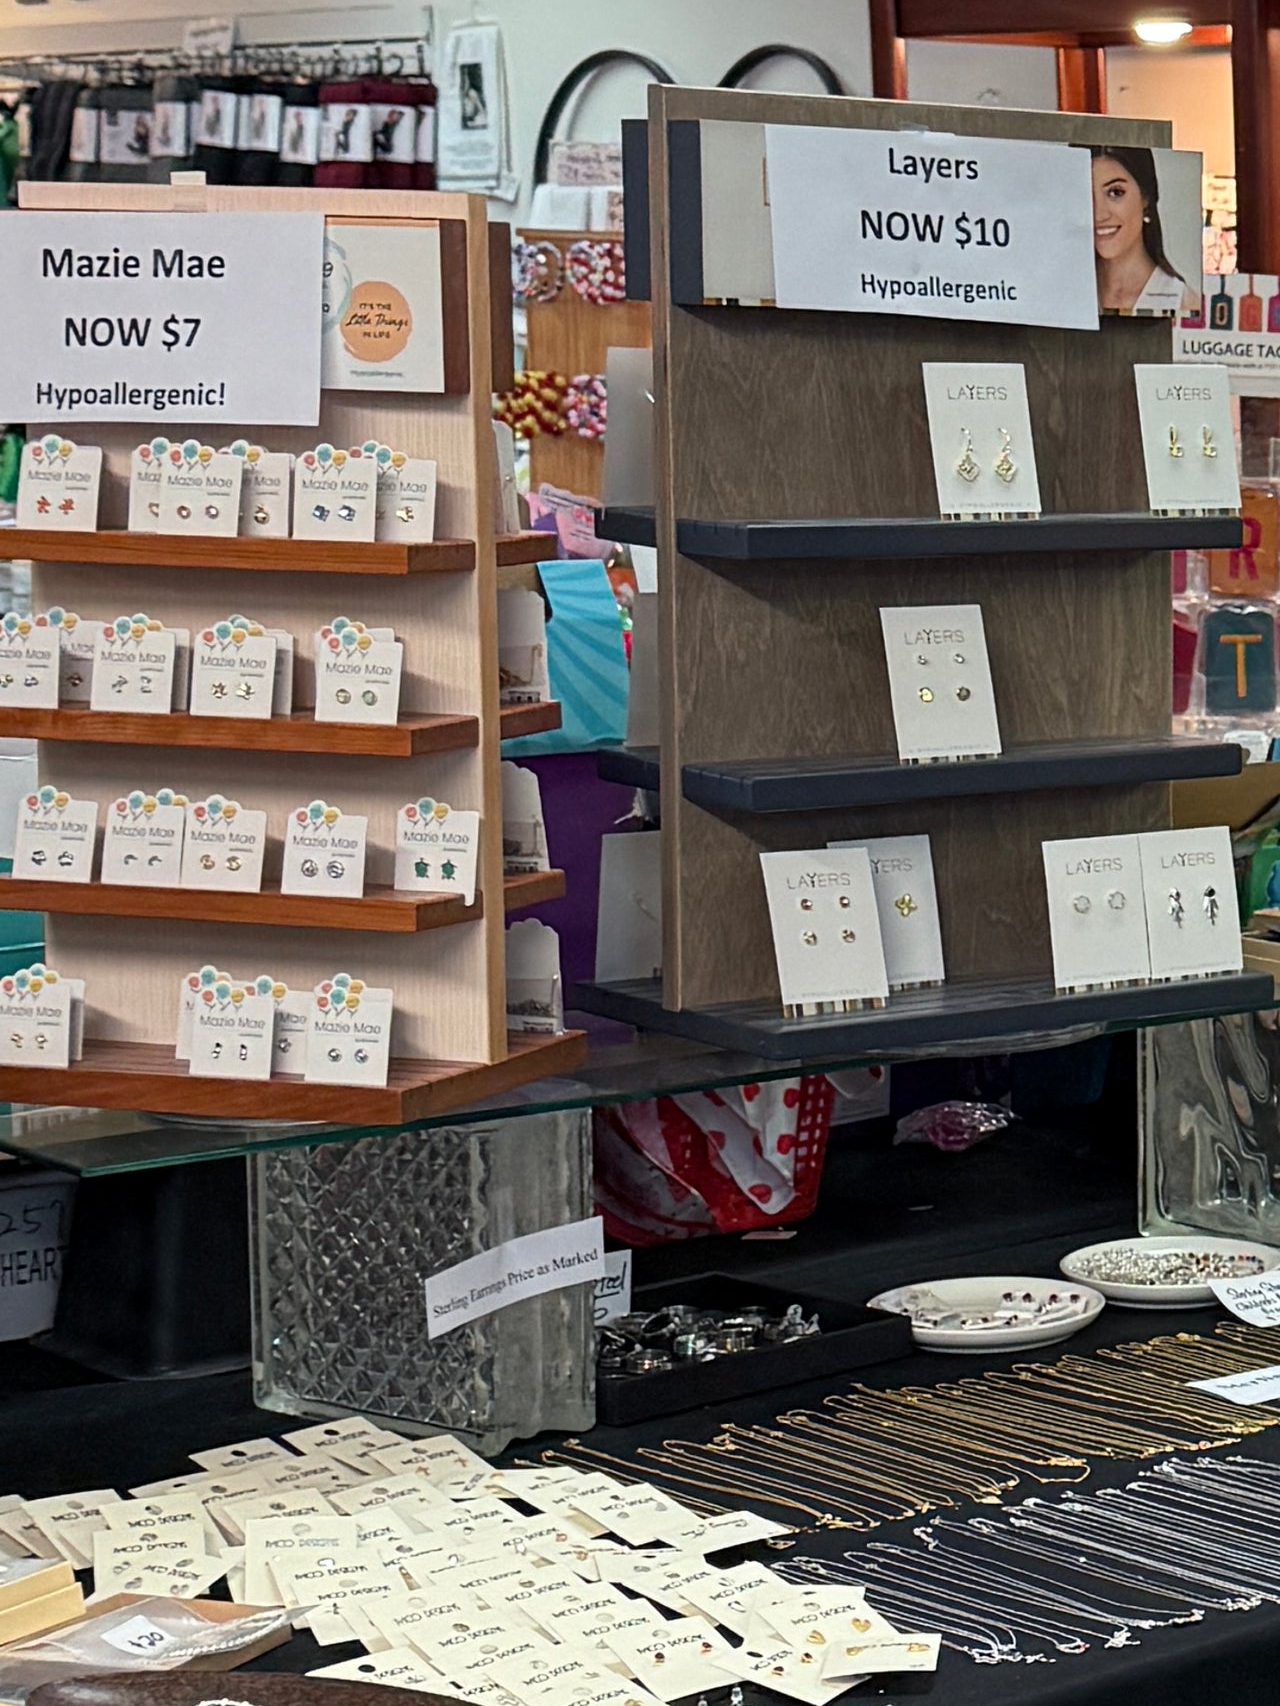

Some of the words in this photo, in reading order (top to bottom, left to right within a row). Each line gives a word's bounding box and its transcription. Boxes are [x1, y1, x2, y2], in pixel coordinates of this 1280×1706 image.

[888, 147, 979, 181] Layers
[860, 211, 945, 244] NOW
[955, 214, 1011, 251] $10
[42, 247, 141, 278] Mazie
[152, 249, 226, 278] Mae
[861, 273, 1018, 303] Hypoallergenic
[65, 317, 152, 347] NOW
[161, 313, 202, 352] $7
[1182, 340, 1254, 357] LUGGAGE
[36, 382, 225, 410] Hypoallergenic!
[946, 385, 1008, 402] LAYERS
[1155, 385, 1213, 402] LAYERS
[904, 629, 965, 646] LAYERS
[1065, 857, 1123, 875] LAYERS
[1160, 850, 1217, 870] LAYERS
[786, 871, 852, 890] LAYERS
[507, 1267, 535, 1285] Price
[537, 1264, 551, 1276] as
[552, 1248, 599, 1273] Marked
